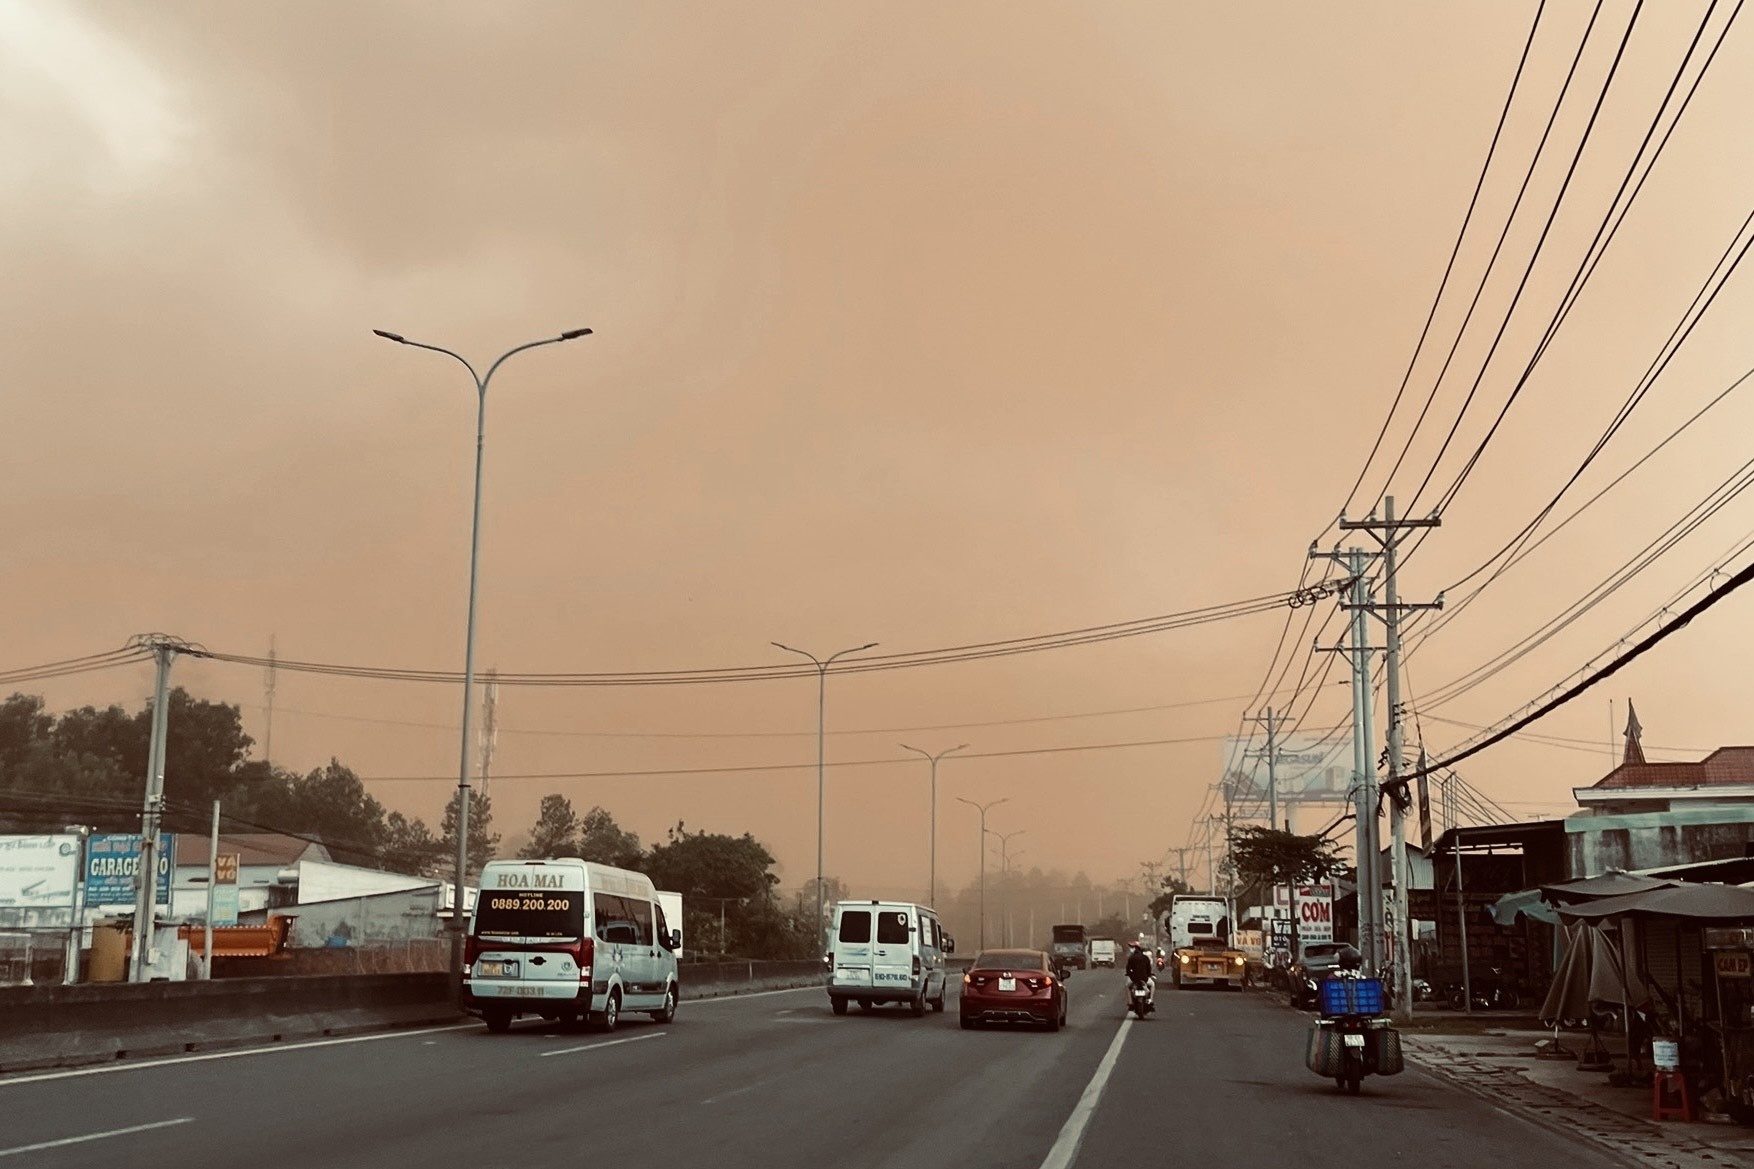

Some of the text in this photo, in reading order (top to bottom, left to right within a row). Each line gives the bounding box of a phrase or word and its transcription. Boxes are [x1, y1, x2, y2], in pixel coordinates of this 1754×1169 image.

[91, 857, 140, 876] GARAGE
[496, 874, 564, 888] HOA MAI
[491, 898, 570, 911] 0889.200.200
